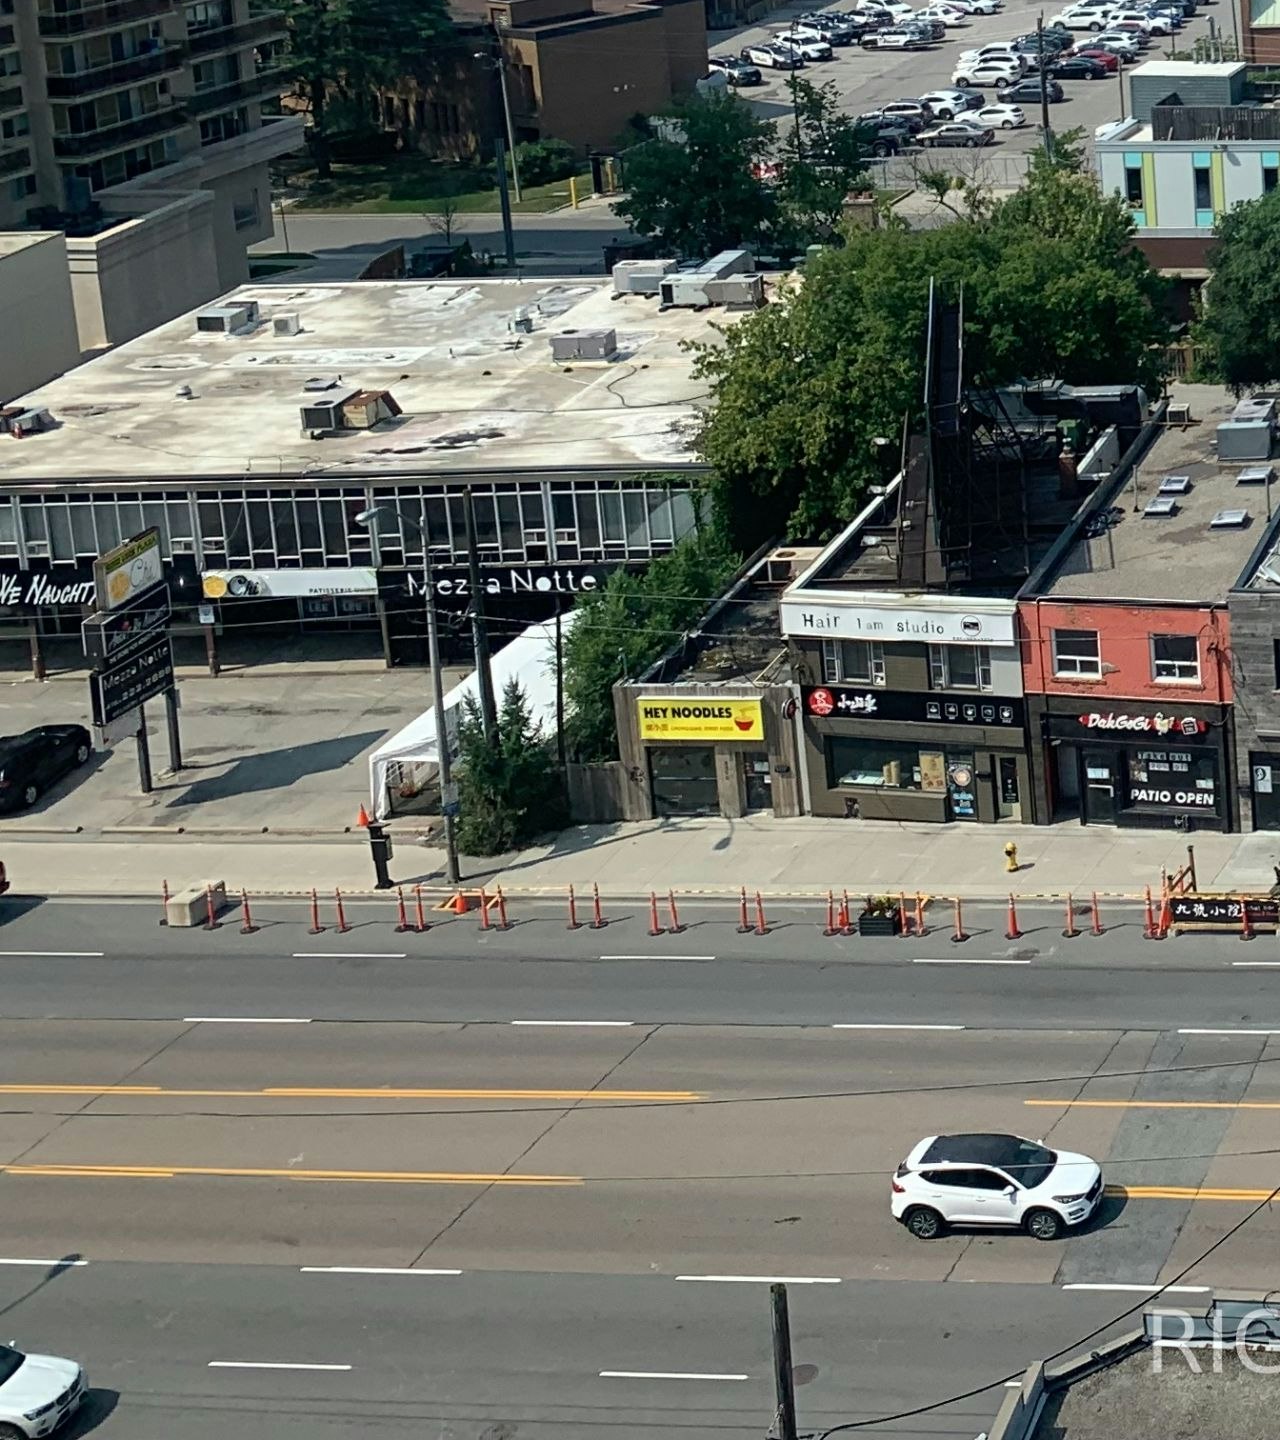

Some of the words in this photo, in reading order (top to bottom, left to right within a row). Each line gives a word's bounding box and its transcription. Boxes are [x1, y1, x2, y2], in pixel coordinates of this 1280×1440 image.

[407, 572, 500, 596] Meza
[510, 568, 597, 593] Notte
[802, 613, 840, 629] Hair
[866, 620, 884, 630] am
[896, 618, 945, 635] studio
[645, 707, 669, 719] HEY
[672, 707, 732, 719] NOODLES
[1130, 789, 1171, 803] PATIO
[1175, 792, 1214, 805] OPEN
